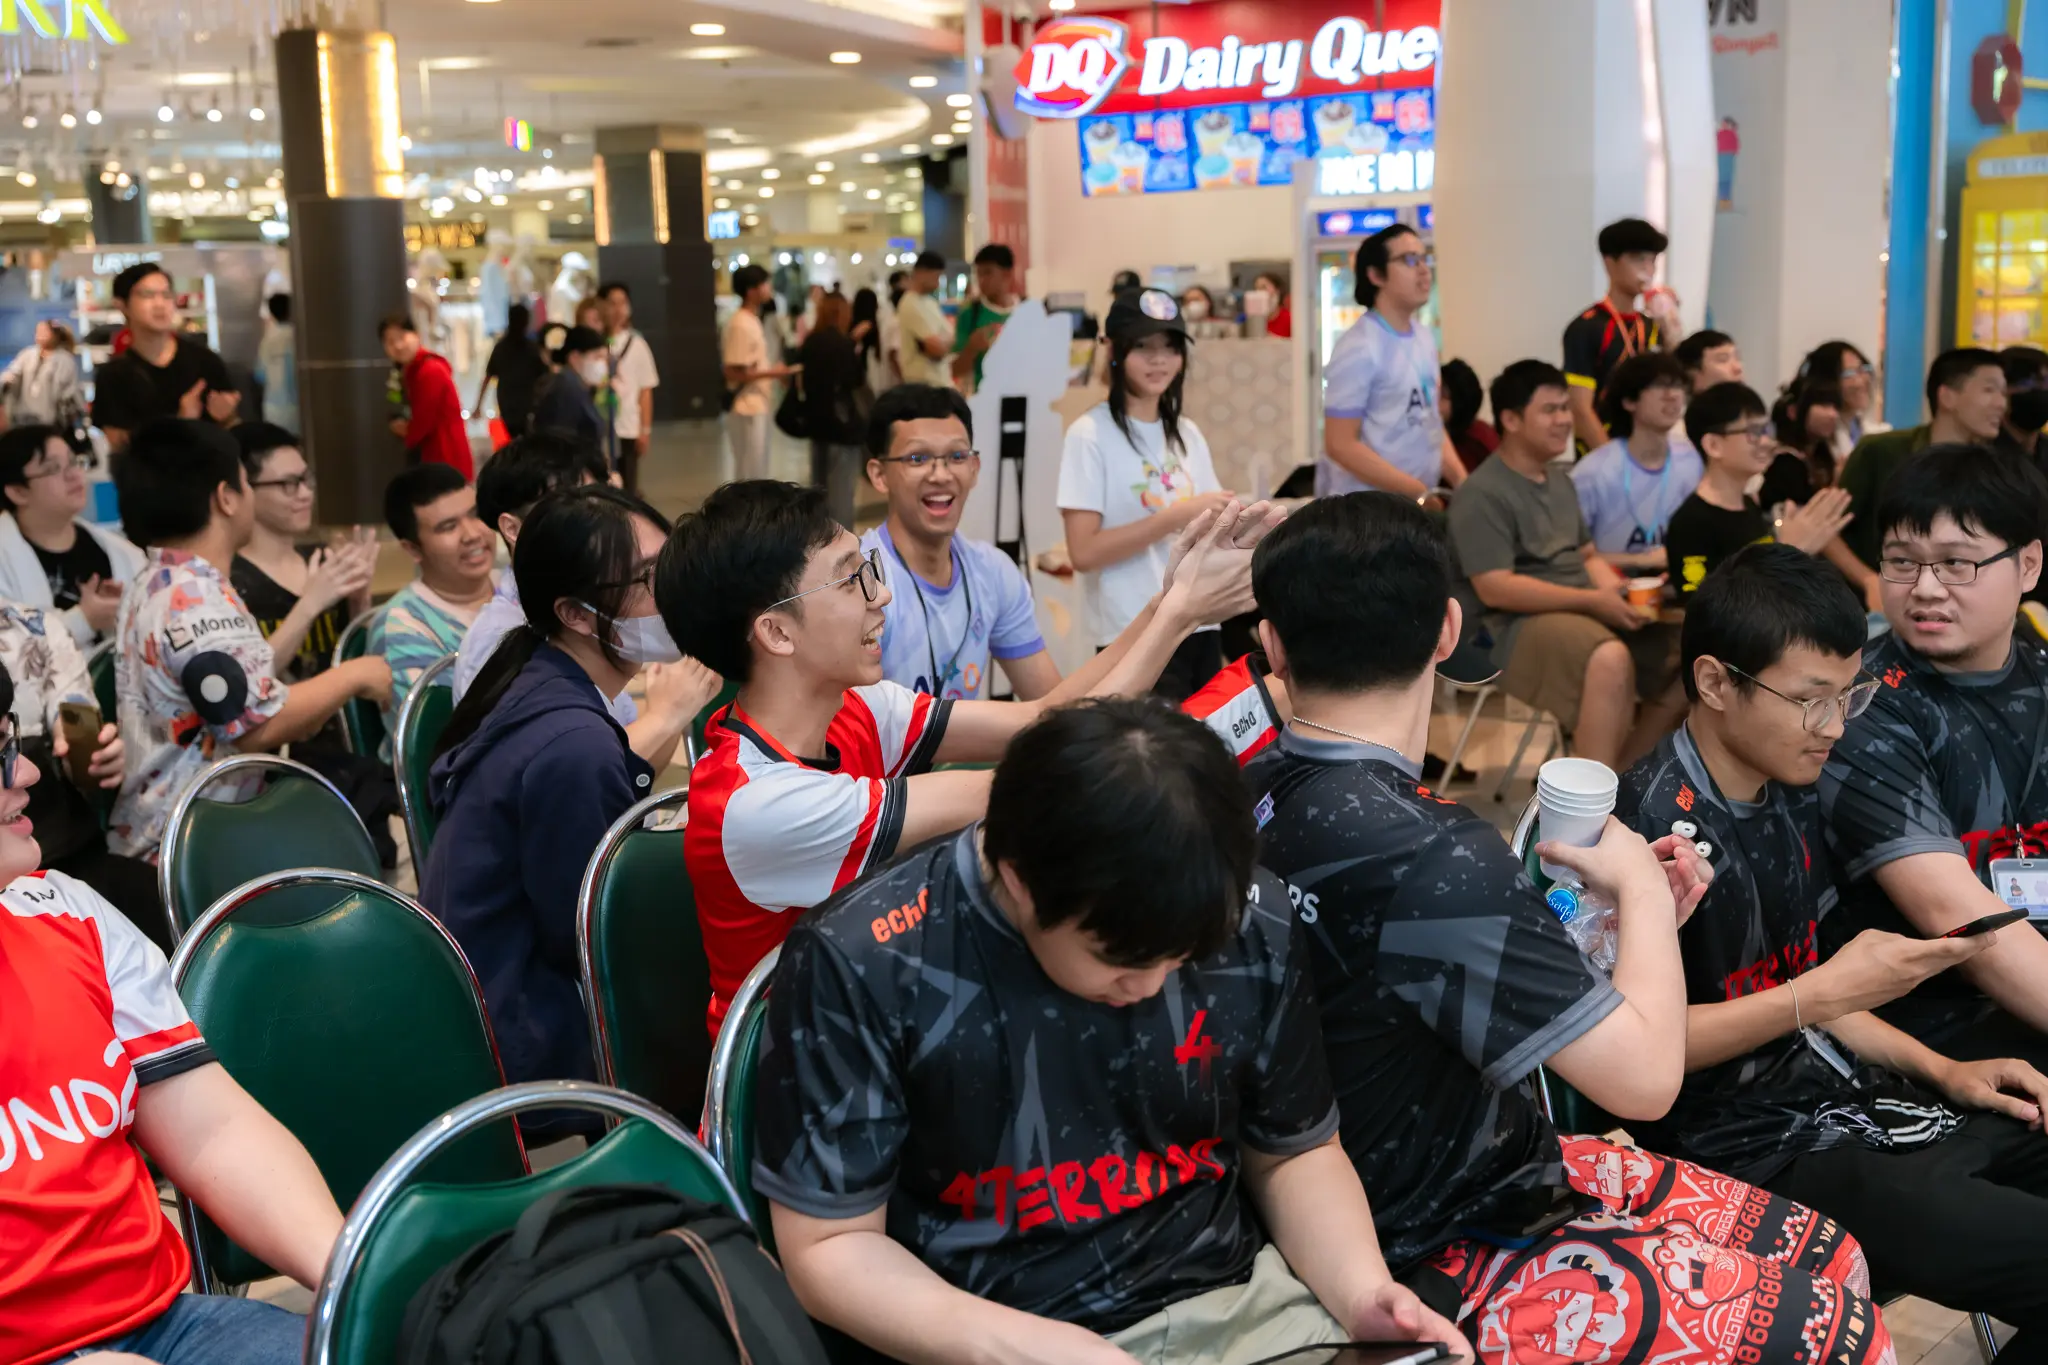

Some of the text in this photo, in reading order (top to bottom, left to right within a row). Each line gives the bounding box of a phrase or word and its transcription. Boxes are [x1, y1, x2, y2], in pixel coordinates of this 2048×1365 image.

[1028, 38, 1107, 95] DQ
[1138, 16, 1438, 98] Dairy Que
[1232, 710, 1257, 739] echo
